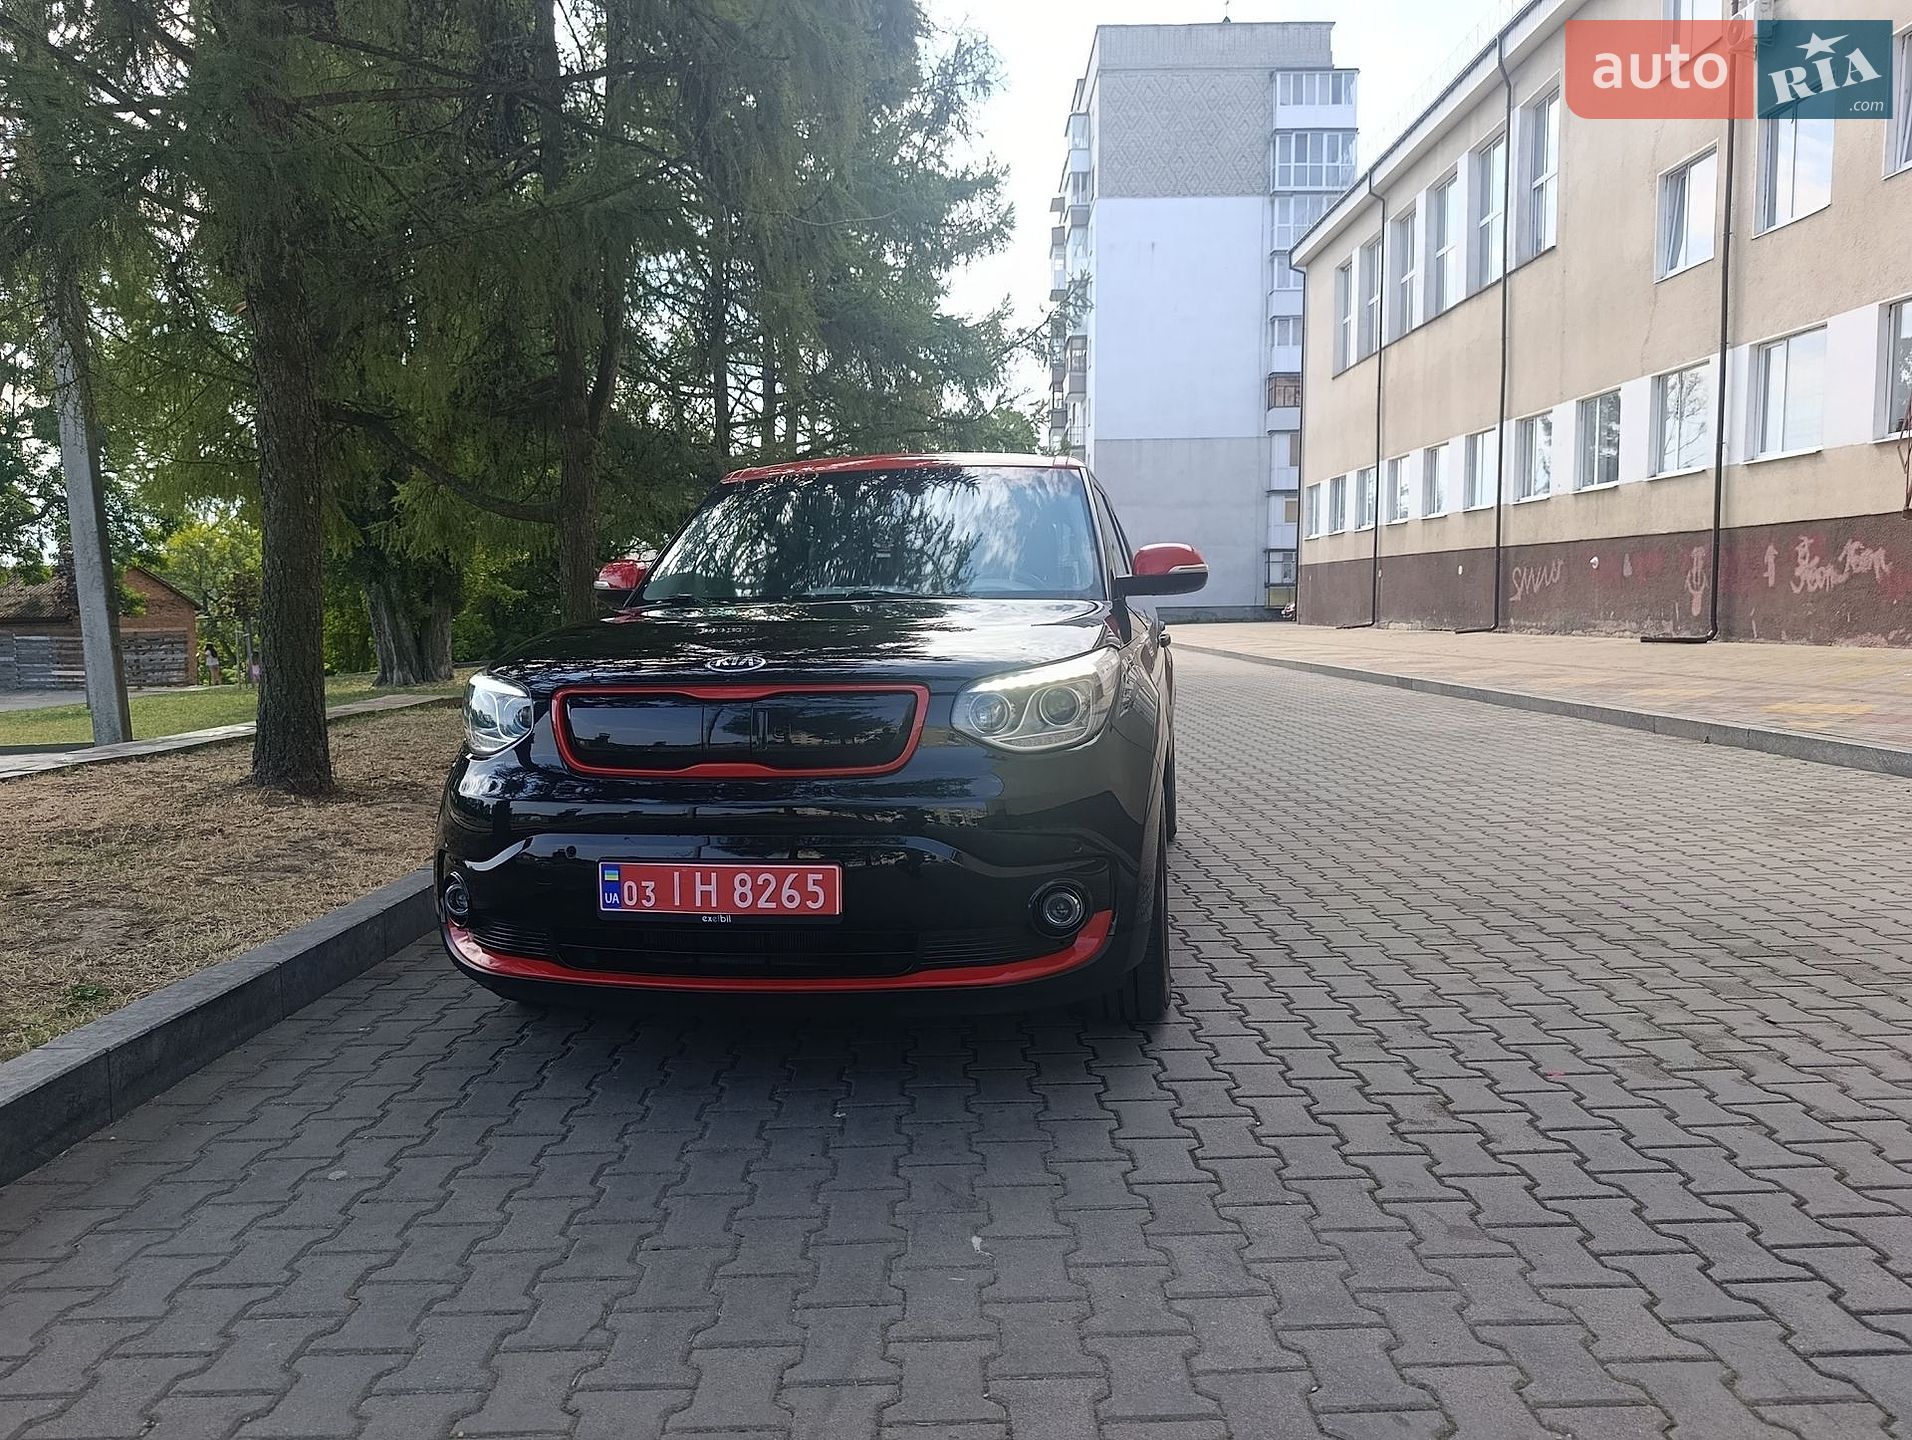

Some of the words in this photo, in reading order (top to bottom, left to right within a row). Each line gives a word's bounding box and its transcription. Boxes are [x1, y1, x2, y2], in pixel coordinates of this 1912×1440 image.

[715, 656, 754, 667] KIA
[623, 880, 656, 908] 03
[733, 872, 825, 909] 8265
[605, 892, 620, 905] UA
